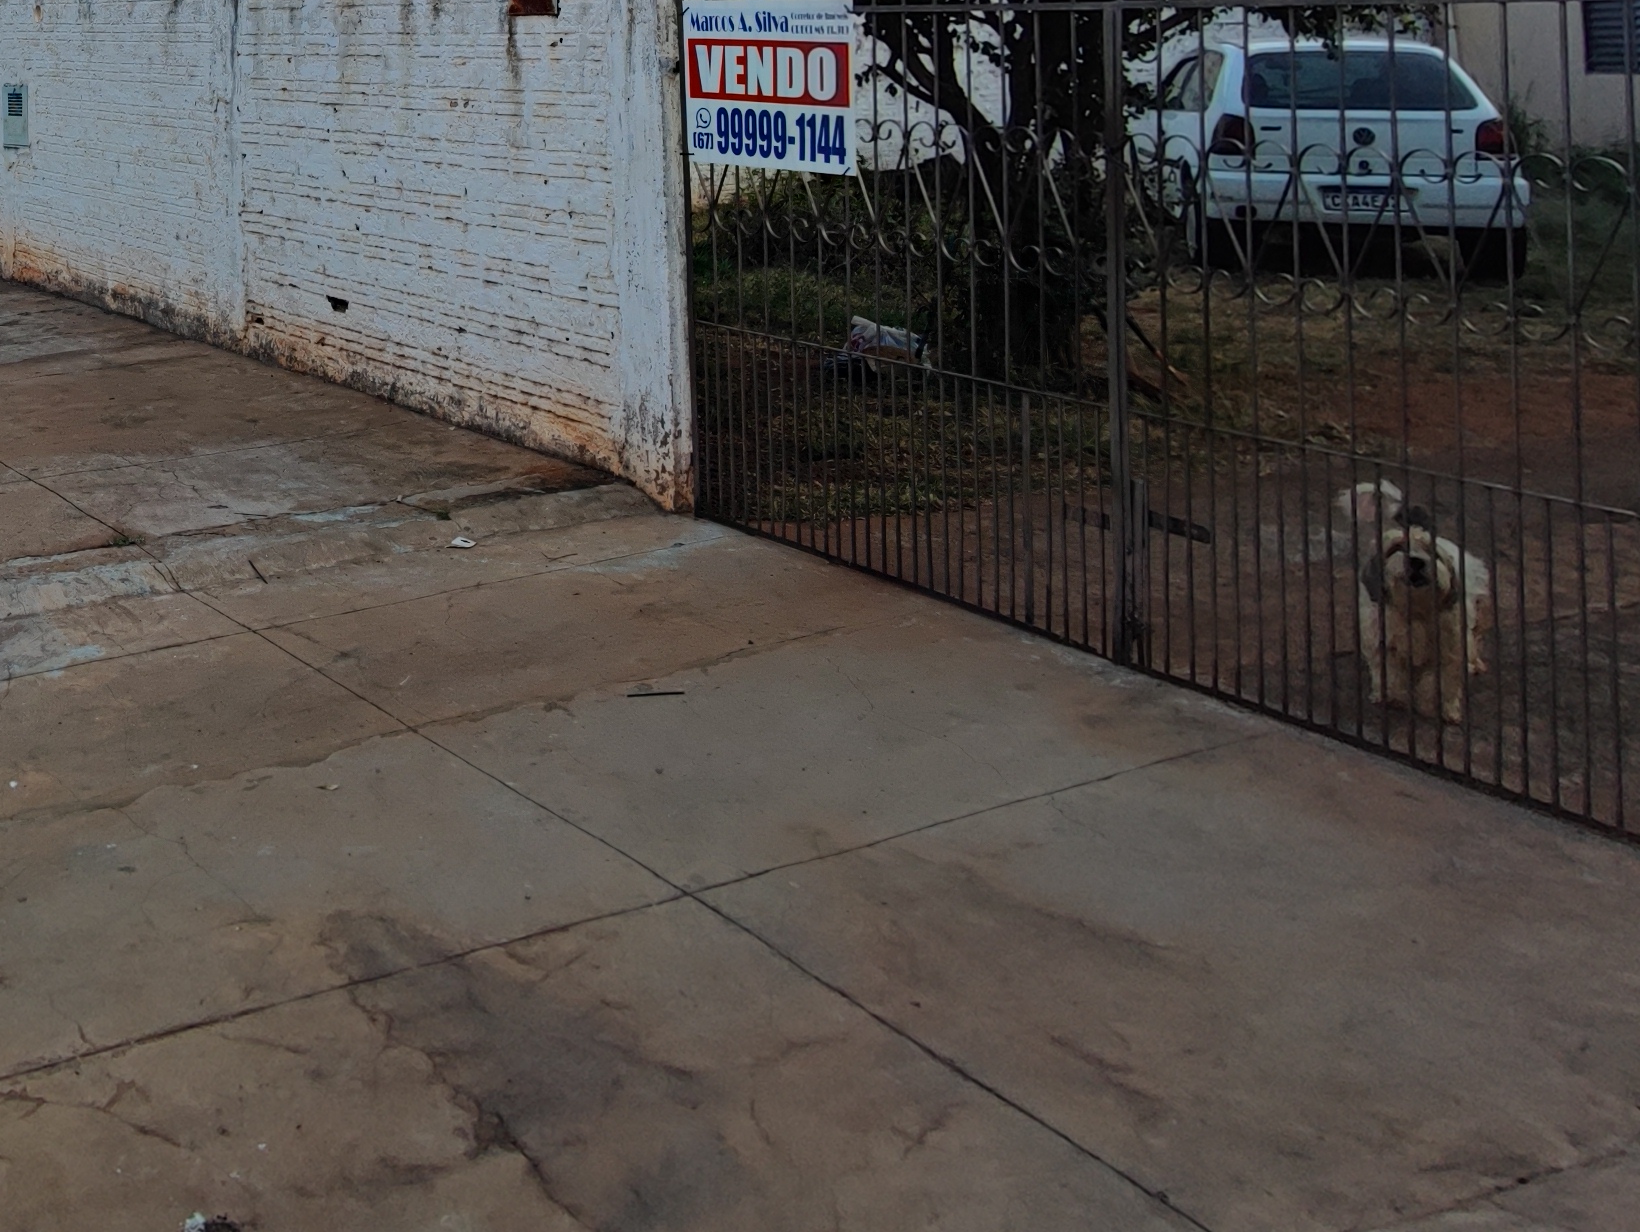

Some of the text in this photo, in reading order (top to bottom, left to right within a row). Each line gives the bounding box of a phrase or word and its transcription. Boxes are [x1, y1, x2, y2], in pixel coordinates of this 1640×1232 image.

[690, 10, 789, 33] Marcos A. Silva
[694, 44, 837, 102] VENDO
[693, 131, 714, 150] (67)
[716, 106, 847, 165] 99999-1144
